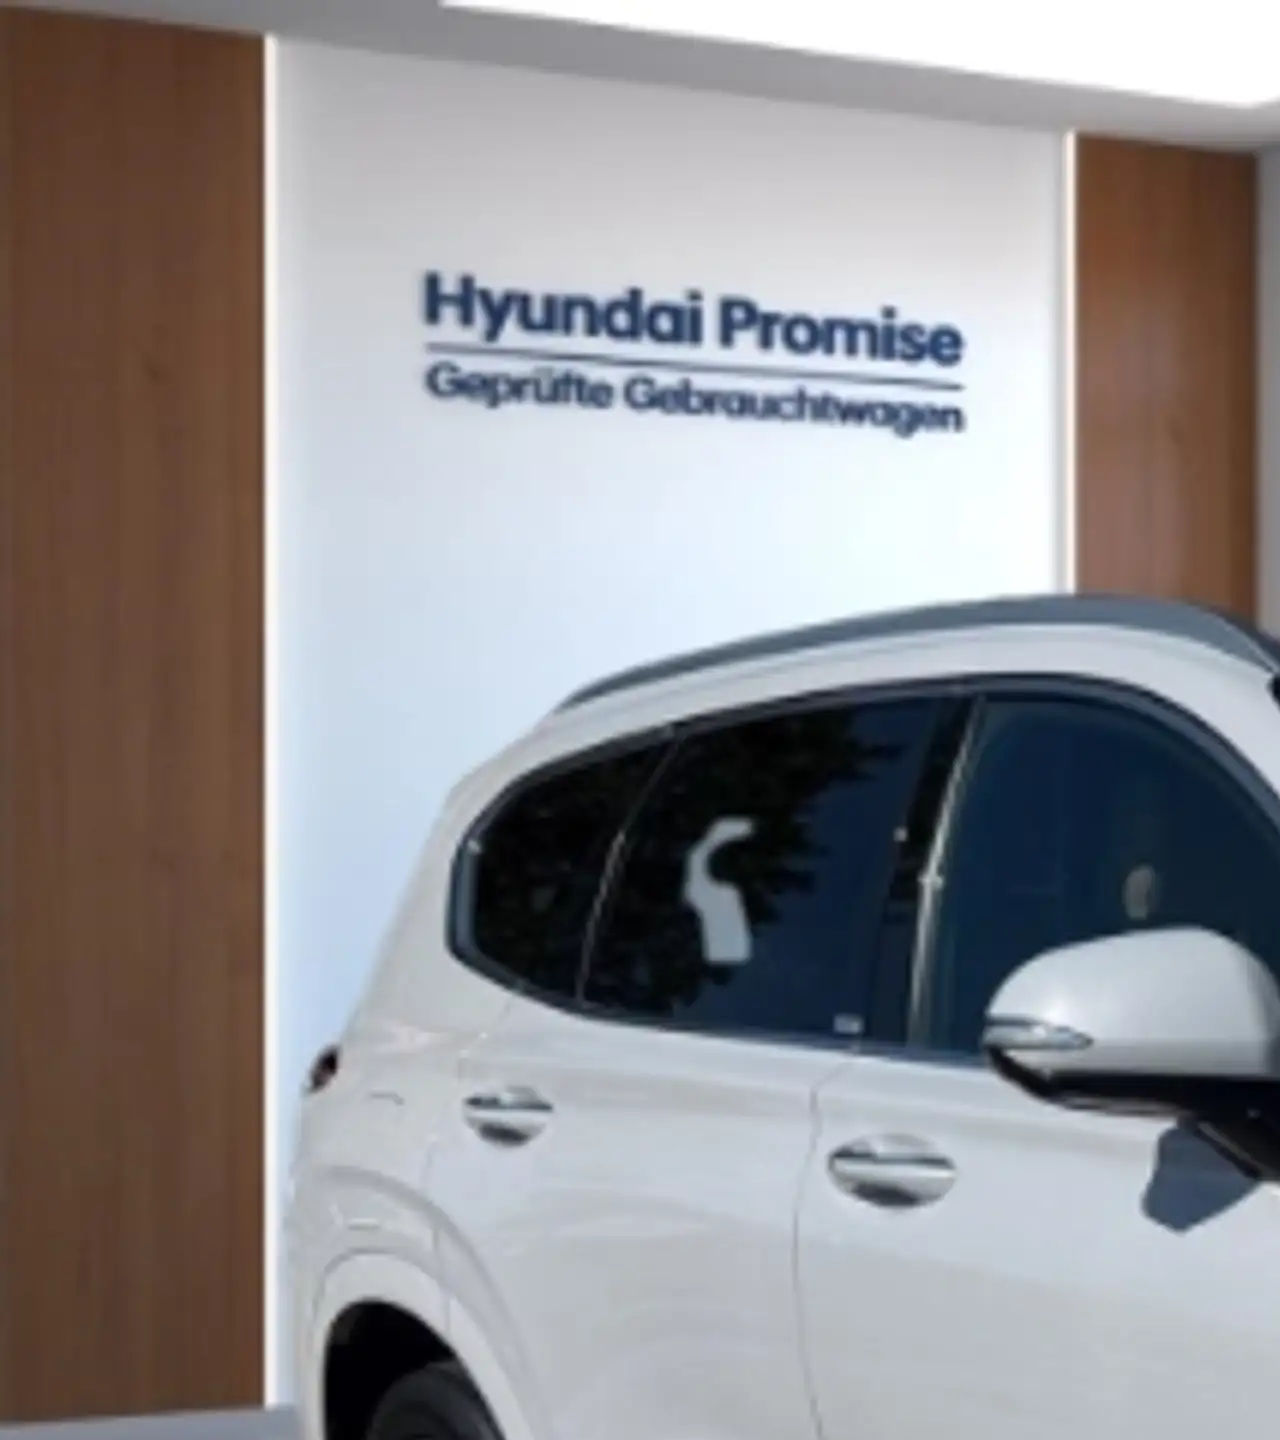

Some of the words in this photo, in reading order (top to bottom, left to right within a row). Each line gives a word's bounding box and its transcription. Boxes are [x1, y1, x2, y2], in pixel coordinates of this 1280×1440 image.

[423, 271, 702, 345] Hyundai
[719, 296, 964, 366] Promise
[424, 361, 615, 410] Geprüfte
[622, 374, 965, 438] Gebrauchtwagen
